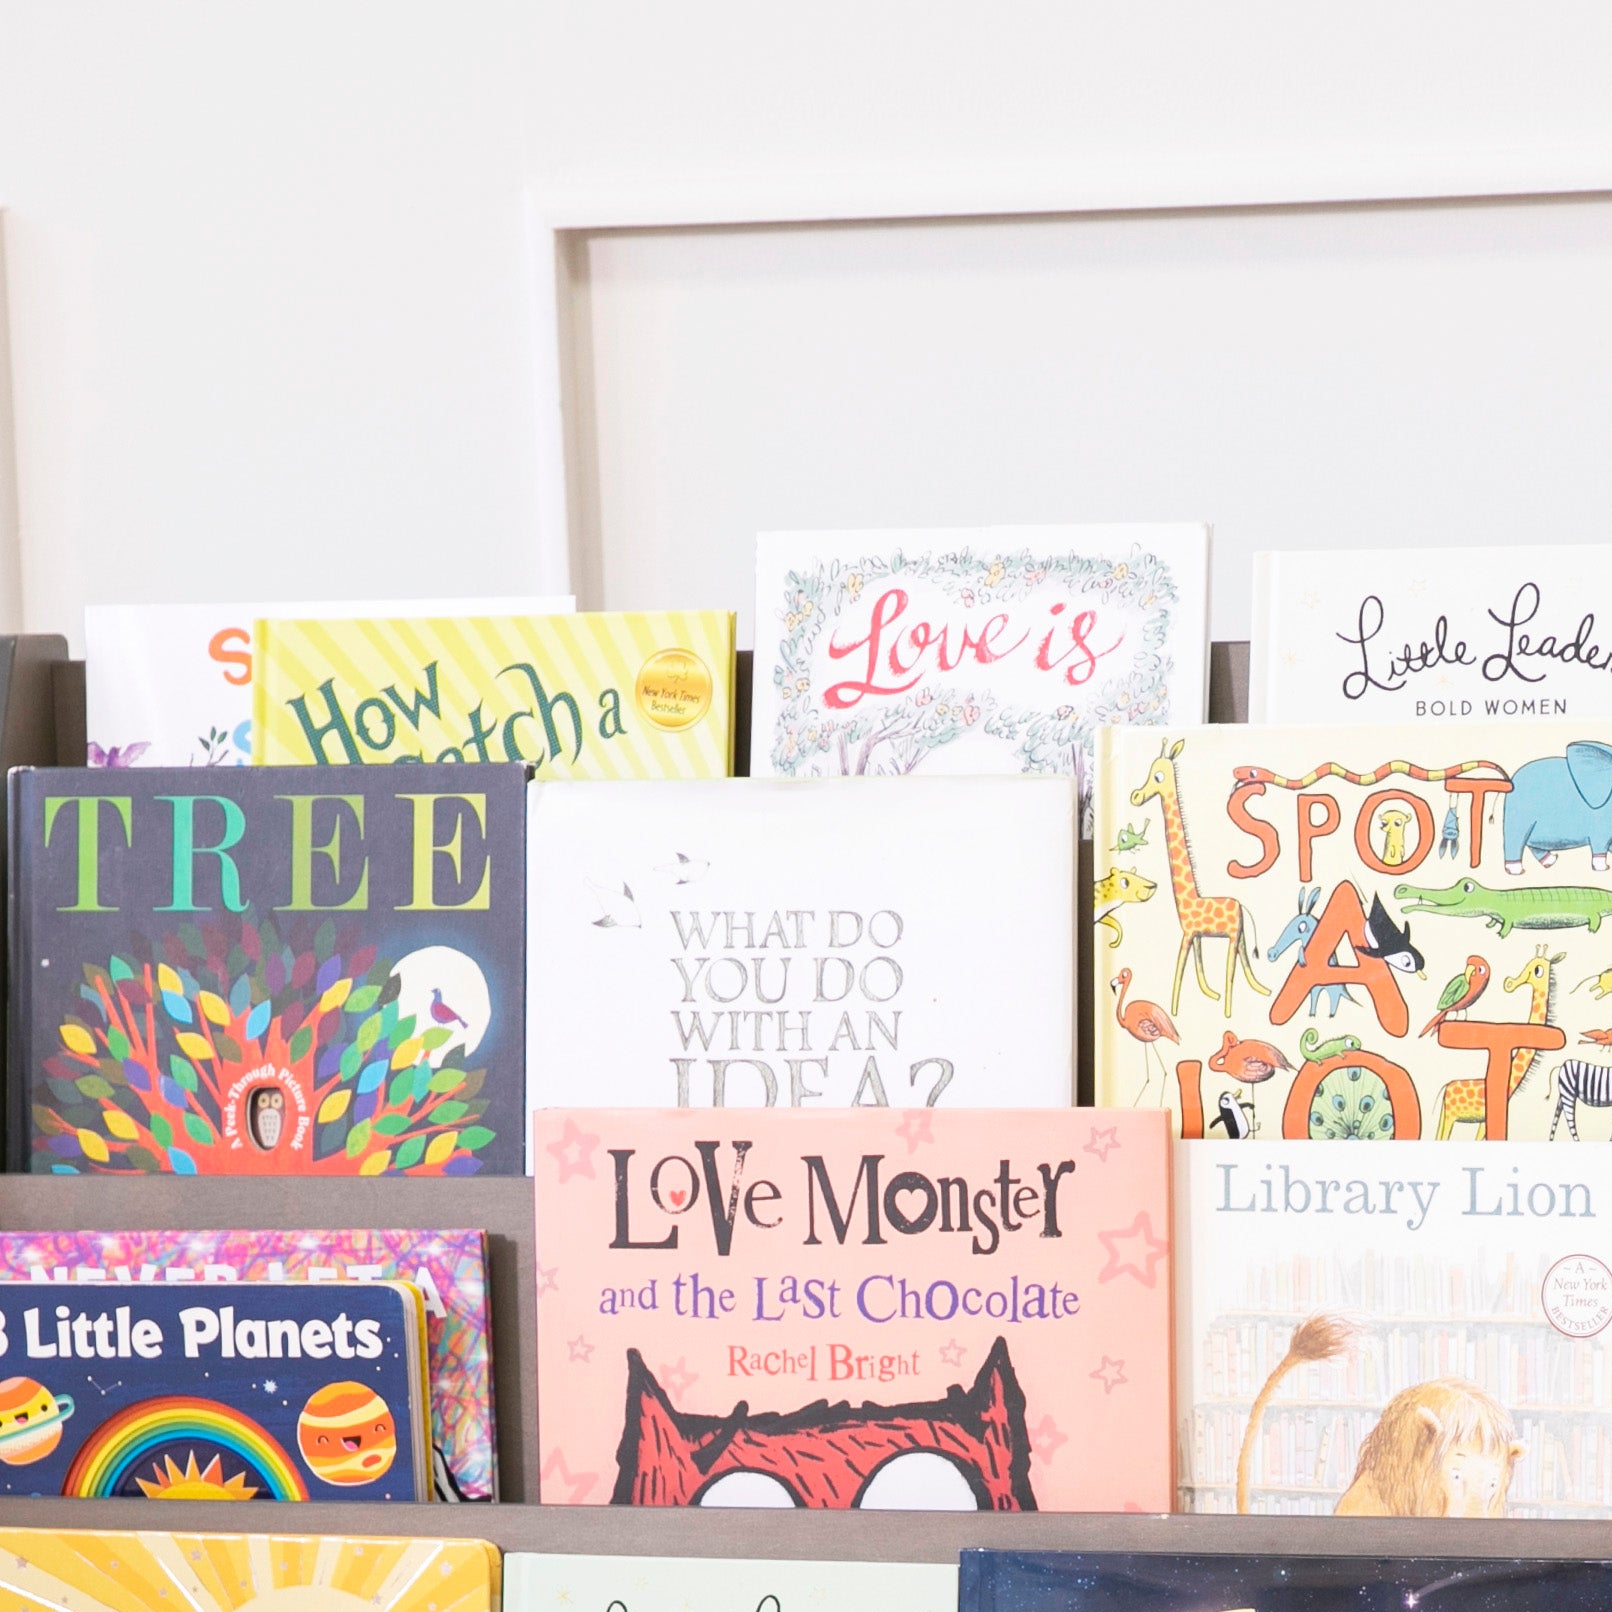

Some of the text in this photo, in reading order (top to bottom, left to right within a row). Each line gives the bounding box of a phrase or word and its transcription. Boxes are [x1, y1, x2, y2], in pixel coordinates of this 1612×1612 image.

[823, 588, 1127, 710] Love is
[1336, 595, 1477, 699] Little
[598, 688, 628, 739] a
[660, 688, 677, 700] York
[1415, 698, 1567, 717] BOLD WOMEN
[44, 793, 493, 912] TREE
[1226, 777, 1513, 882] SPOT
[669, 910, 904, 950] WHAT DO
[670, 956, 904, 1004] YOU DO
[1269, 879, 1410, 1038] A
[670, 1010, 903, 1052] WITH AN
[224, 1062, 310, 1151] A Peek-Through Picture Book
[801, 1154, 1076, 1255] Monster
[1215, 1163, 1597, 1231] Library Lion
[600, 1279, 659, 1316] and
[671, 1272, 737, 1322] the
[753, 1275, 842, 1323] Last
[1553, 1277, 1608, 1291] New York
[1563, 1294, 1599, 1308] Times
[24, 1306, 163, 1358] Little
[179, 1306, 383, 1358] Planets
[1551, 1306, 1609, 1332] BESTSELLER
[726, 1344, 921, 1383] Rachel Bright
